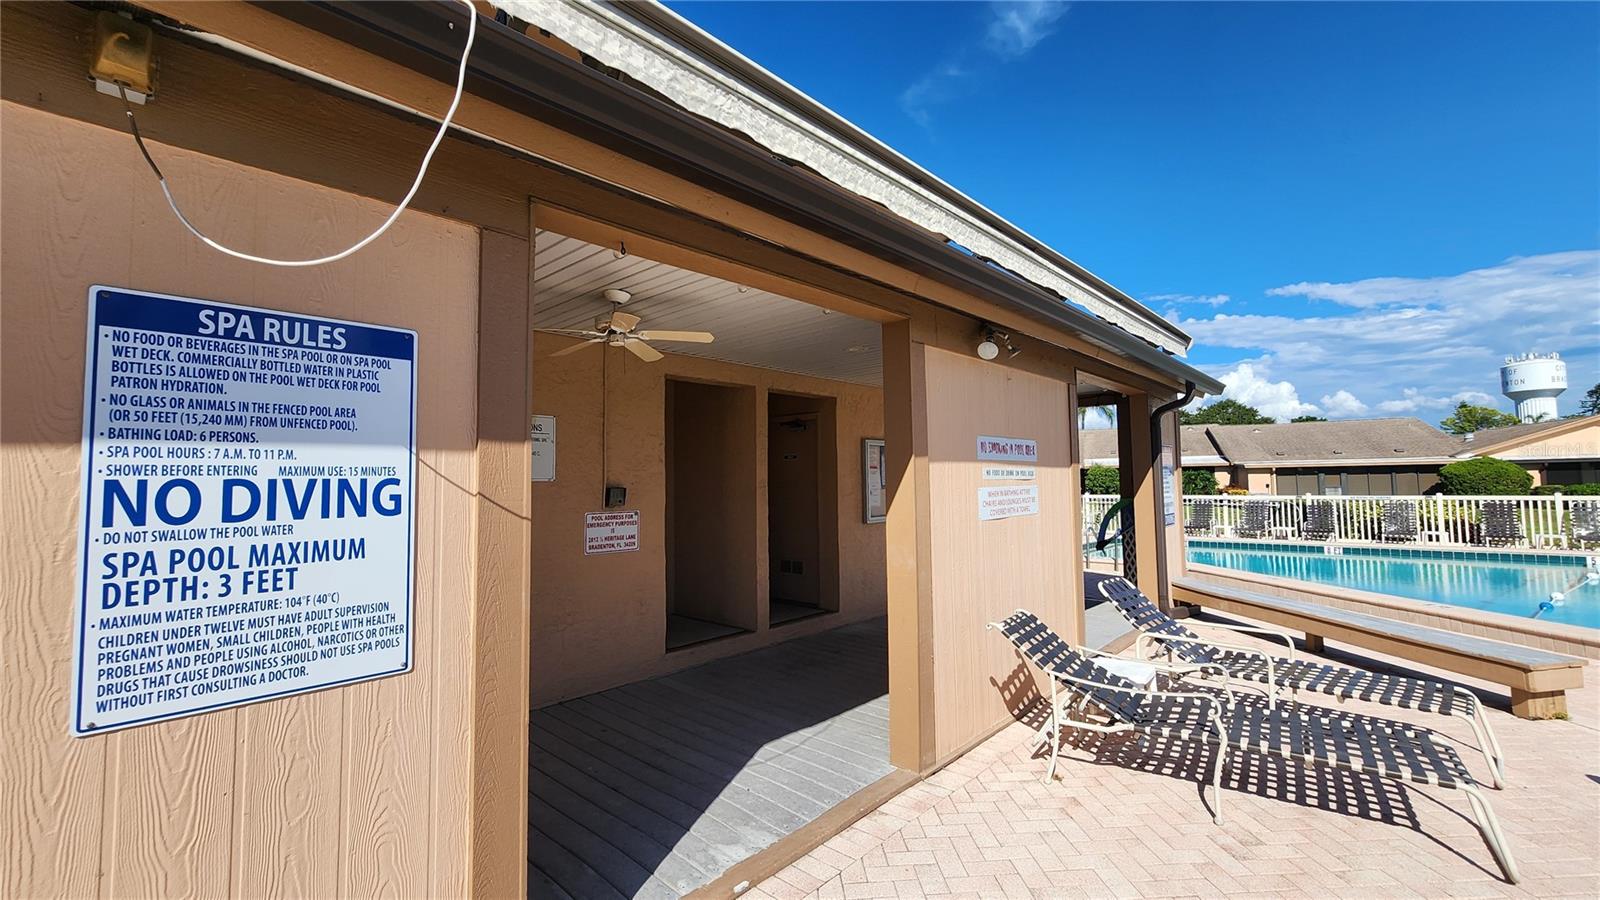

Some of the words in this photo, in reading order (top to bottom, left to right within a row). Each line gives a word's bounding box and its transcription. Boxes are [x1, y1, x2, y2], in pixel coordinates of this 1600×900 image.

[198, 309, 255, 339] SPA
[263, 317, 346, 349] RULES
[111, 344, 138, 358] WET
[140, 347, 174, 361] DECK.
[177, 351, 258, 369] COMMERCIALLY
[259, 359, 301, 373] BOTTLED
[303, 363, 333, 376] WATER
[335, 366, 344, 377] IN
[346, 367, 379, 380] PLASTIC
[112, 329, 129, 342] NO
[133, 331, 164, 346] FOOD
[167, 335, 182, 348] OR
[185, 337, 246, 354] BEVERAGES
[248, 344, 259, 356] IN
[260, 345, 279, 358] THE
[281, 348, 298, 360] SPA
[300, 350, 324, 362] POOL
[325, 352, 338, 364] OR
[339, 354, 352, 365] ON
[353, 356, 369, 367] SPA
[370, 357, 391, 369] POOL
[110, 375, 157, 390] PATRON
[160, 378, 227, 394] HYDRATION.
[111, 359, 162, 375] BOTTLES
[165, 364, 176, 376] IS
[178, 365, 229, 380] ALLOWED
[231, 370, 246, 382] ON
[248, 371, 267, 384] THE
[269, 373, 294, 386] POOL
[296, 375, 316, 387] WET
[317, 377, 340, 390] DECK
[341, 379, 358, 391] FOR
[359, 381, 380, 393] POOL
[108, 408, 130, 422] (OR
[133, 410, 148, 422] 50
[151, 410, 178, 423] FEET
[180, 412, 222, 426] (15,240
[224, 414, 247, 428] MM)
[249, 415, 277, 427] FROM
[279, 416, 327, 429] UNFENCED
[329, 419, 357, 432] POOL).
[109, 393, 127, 406] NO
[129, 394, 166, 408] GLASS
[169, 396, 184, 409] OR
[187, 398, 235, 412] ANIMALS
[238, 401, 249, 412] IN
[251, 401, 270, 413] THE
[272, 403, 307, 415] FENCED
[309, 405, 332, 417] POOL
[333, 407, 356, 418] AREA
[107, 426, 161, 440] BATHING
[164, 428, 196, 441] LOAD:
[199, 430, 206, 441] 6
[208, 430, 259, 443] PERSONS.
[988, 442, 1008, 454] SMOKING
[106, 445, 129, 457] SPA
[133, 446, 163, 458] POOL
[213, 448, 220, 459] 7
[222, 447, 246, 459] A.M.
[248, 448, 260, 459] TO
[263, 449, 274, 459] 11
[277, 449, 296, 460] P.M.
[106, 464, 158, 476] SHOWER
[161, 464, 203, 476] BEFORE
[206, 464, 257, 476] ENTERING
[278, 465, 325, 476] MAXIMUM
[327, 465, 346, 476] USE:
[348, 466, 358, 476] 15
[360, 466, 396, 476] MINUTES
[101, 477, 201, 528] NO
[221, 477, 401, 523] DIVING
[103, 531, 120, 544] DO
[123, 530, 148, 543] NOT
[151, 527, 207, 542] SWALLOW
[209, 526, 229, 538] THE
[232, 525, 258, 537] POOL
[261, 524, 293, 536] WATER
[101, 550, 157, 579] SPA
[168, 545, 239, 574] POOL
[248, 537, 365, 568] MAXIMUM
[101, 575, 208, 609] DEPTH:
[217, 573, 231, 597] 3
[242, 566, 298, 595] FEET
[97, 629, 159, 649] CHILDREN
[162, 624, 201, 640] UNDER
[203, 618, 244, 635] TWELVE
[247, 615, 275, 629] MUST
[277, 611, 302, 625] HAVE
[303, 608, 333, 621] ADULT
[334, 601, 389, 618] SUPERVISION
[98, 611, 161, 630] MAXIMUM
[164, 606, 203, 622] WATER
[205, 598, 282, 617] TEMPERATURE:
[97, 644, 163, 665] PREGNANT
[165, 638, 213, 655] WOMEN,
[216, 632, 250, 648] SMALL
[253, 625, 303, 642] CHILDREN,
[306, 620, 339, 635] PEOPLE
[341, 617, 363, 630] WITH
[365, 612, 395, 626] HEALTH
[97, 659, 163, 681] PROBLEMS
[166, 655, 190, 670] AND
[193, 649, 233, 666] PEOPLE
[236, 643, 267, 659] USING
[269, 637, 314, 654] ALCOHOL,
[317, 629, 363, 646] NARCOTICS
[365, 627, 377, 639] OR
[378, 623, 404, 637] OTHER
[96, 678, 139, 697] DRUGS
[141, 673, 171, 689] THAT
[173, 667, 208, 684] CAUSE
[211, 656, 278, 678] DROWSINESS
[280, 650, 318, 666] SHOULD
[320, 646, 338, 659] NOT
[339, 643, 355, 656] USE
[357, 641, 372, 653] SPA
[374, 636, 399, 650] POOLS
[95, 691, 154, 713] WITHOUT
[156, 685, 189, 702] FIRST
[191, 673, 256, 696] CONSULTING
[258, 672, 265, 684] A
[268, 665, 308, 682] DOCTOR.
